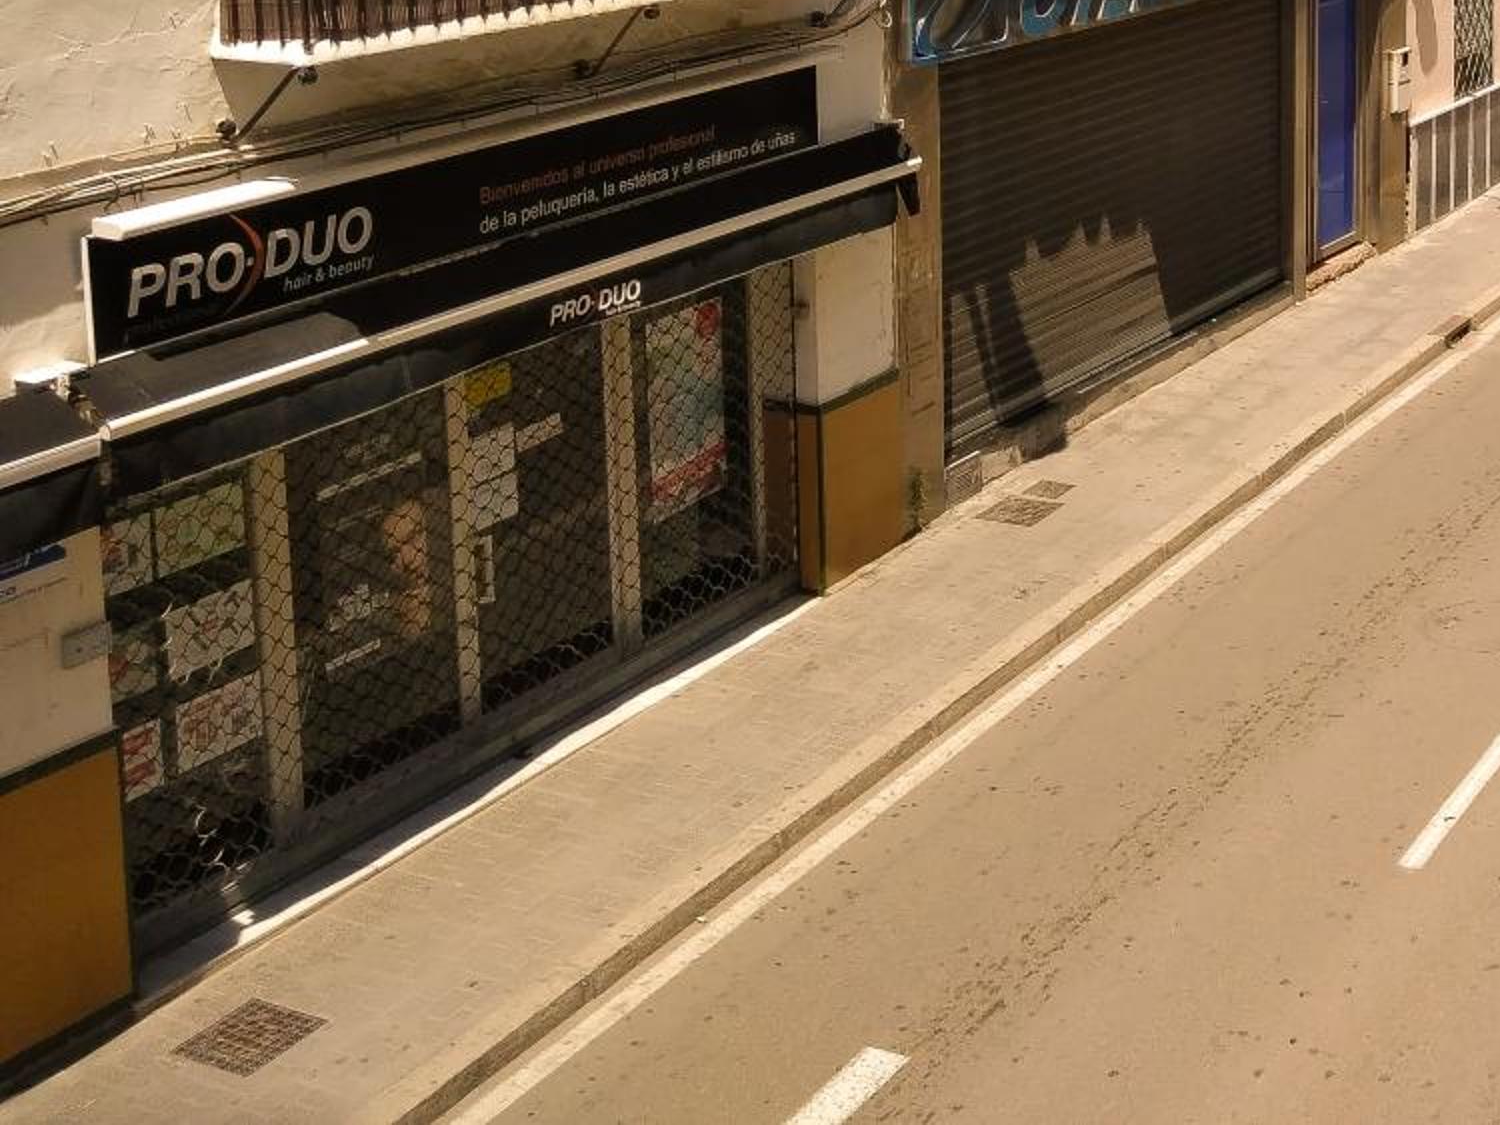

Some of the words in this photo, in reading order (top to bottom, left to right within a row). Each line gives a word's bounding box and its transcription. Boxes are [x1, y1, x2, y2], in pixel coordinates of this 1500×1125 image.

[479, 214, 499, 234] de
[503, 209, 517, 228] la
[603, 179, 615, 199] la
[619, 166, 669, 193] estética
[683, 157, 693, 174] el
[697, 145, 748, 171] estilismo
[751, 138, 765, 156] de
[768, 131, 796, 151] uñas
[479, 167, 569, 204] Bienvenidos
[282, 269, 311, 293] hair
[315, 268, 324, 283] &
[329, 253, 376, 279] beauty
